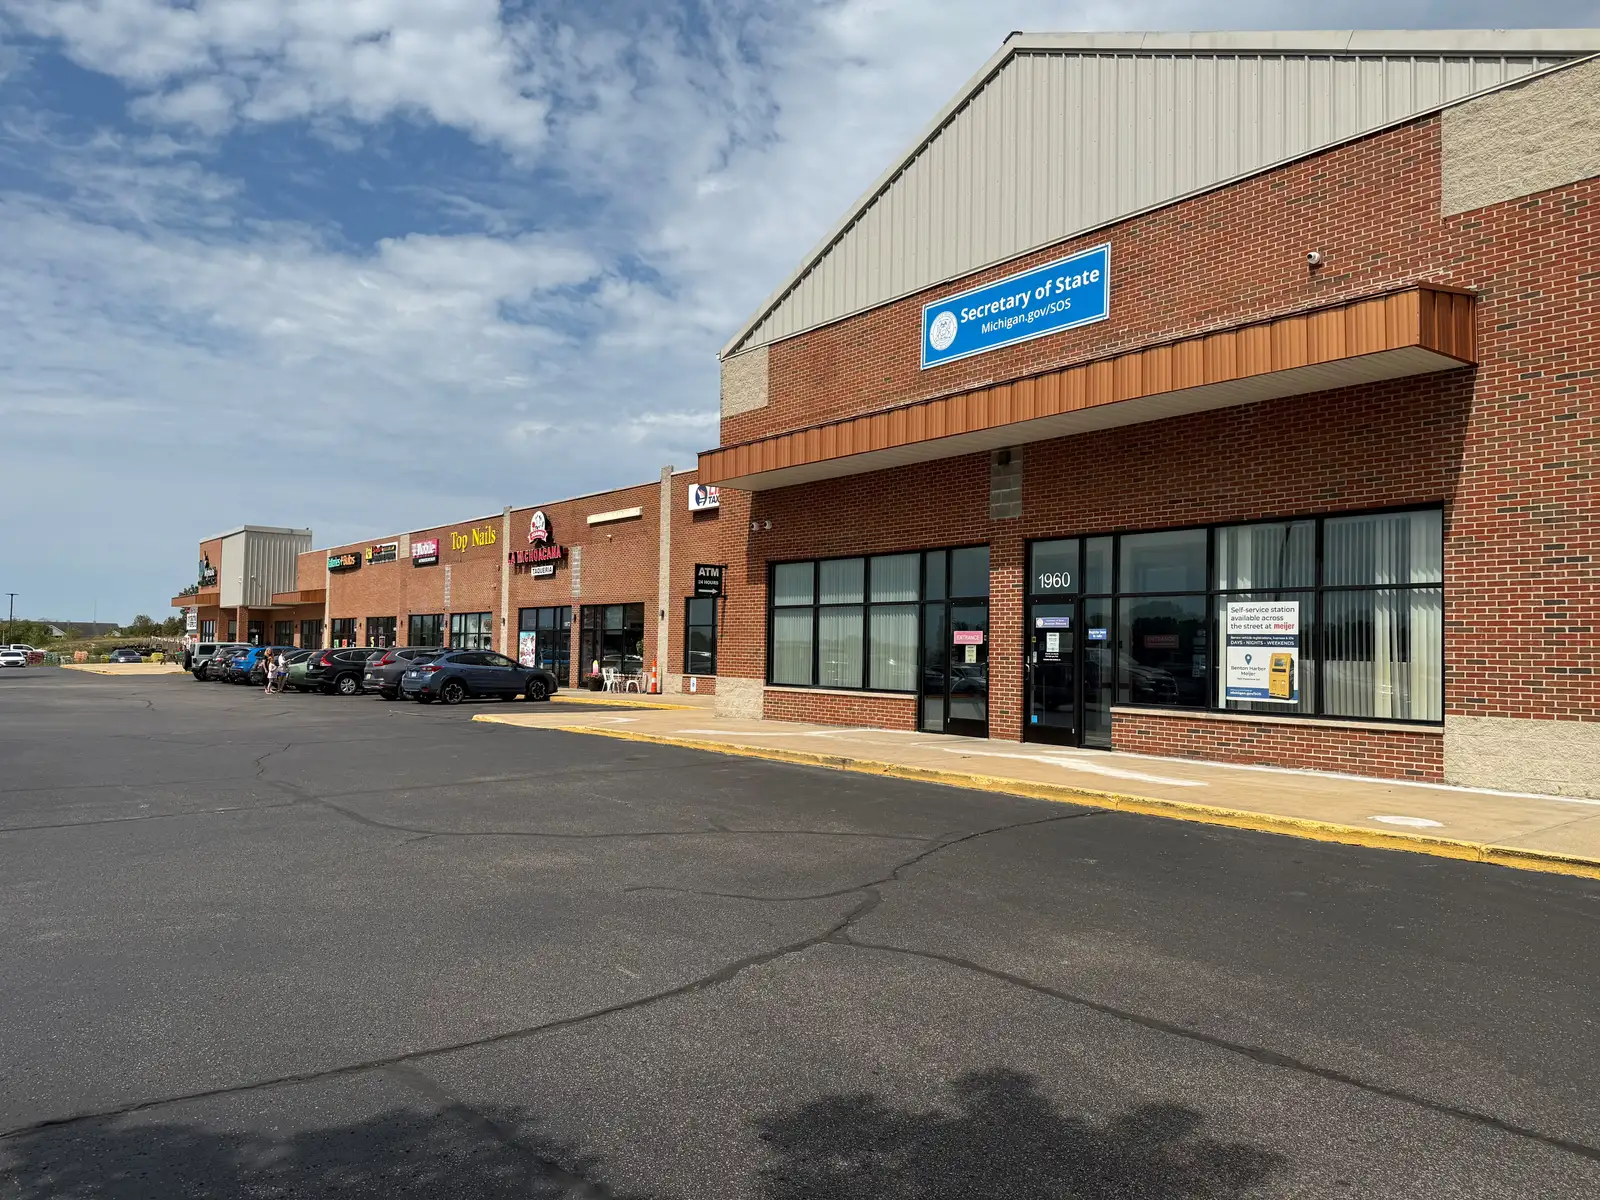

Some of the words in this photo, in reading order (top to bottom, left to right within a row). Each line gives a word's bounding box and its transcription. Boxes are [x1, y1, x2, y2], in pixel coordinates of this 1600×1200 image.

[961, 290, 1031, 323] Secretary
[1035, 280, 1052, 300] of
[1055, 269, 1100, 294] State
[981, 298, 1071, 334] Michigan.gov/SOS
[708, 486, 720, 495] LI
[451, 531, 468, 553] Top
[472, 525, 496, 547] Nails
[532, 566, 552, 574] TAQUERIA
[698, 567, 719, 577] ATM
[1038, 572, 1071, 588] 1960
[1274, 622, 1294, 630] meijer
